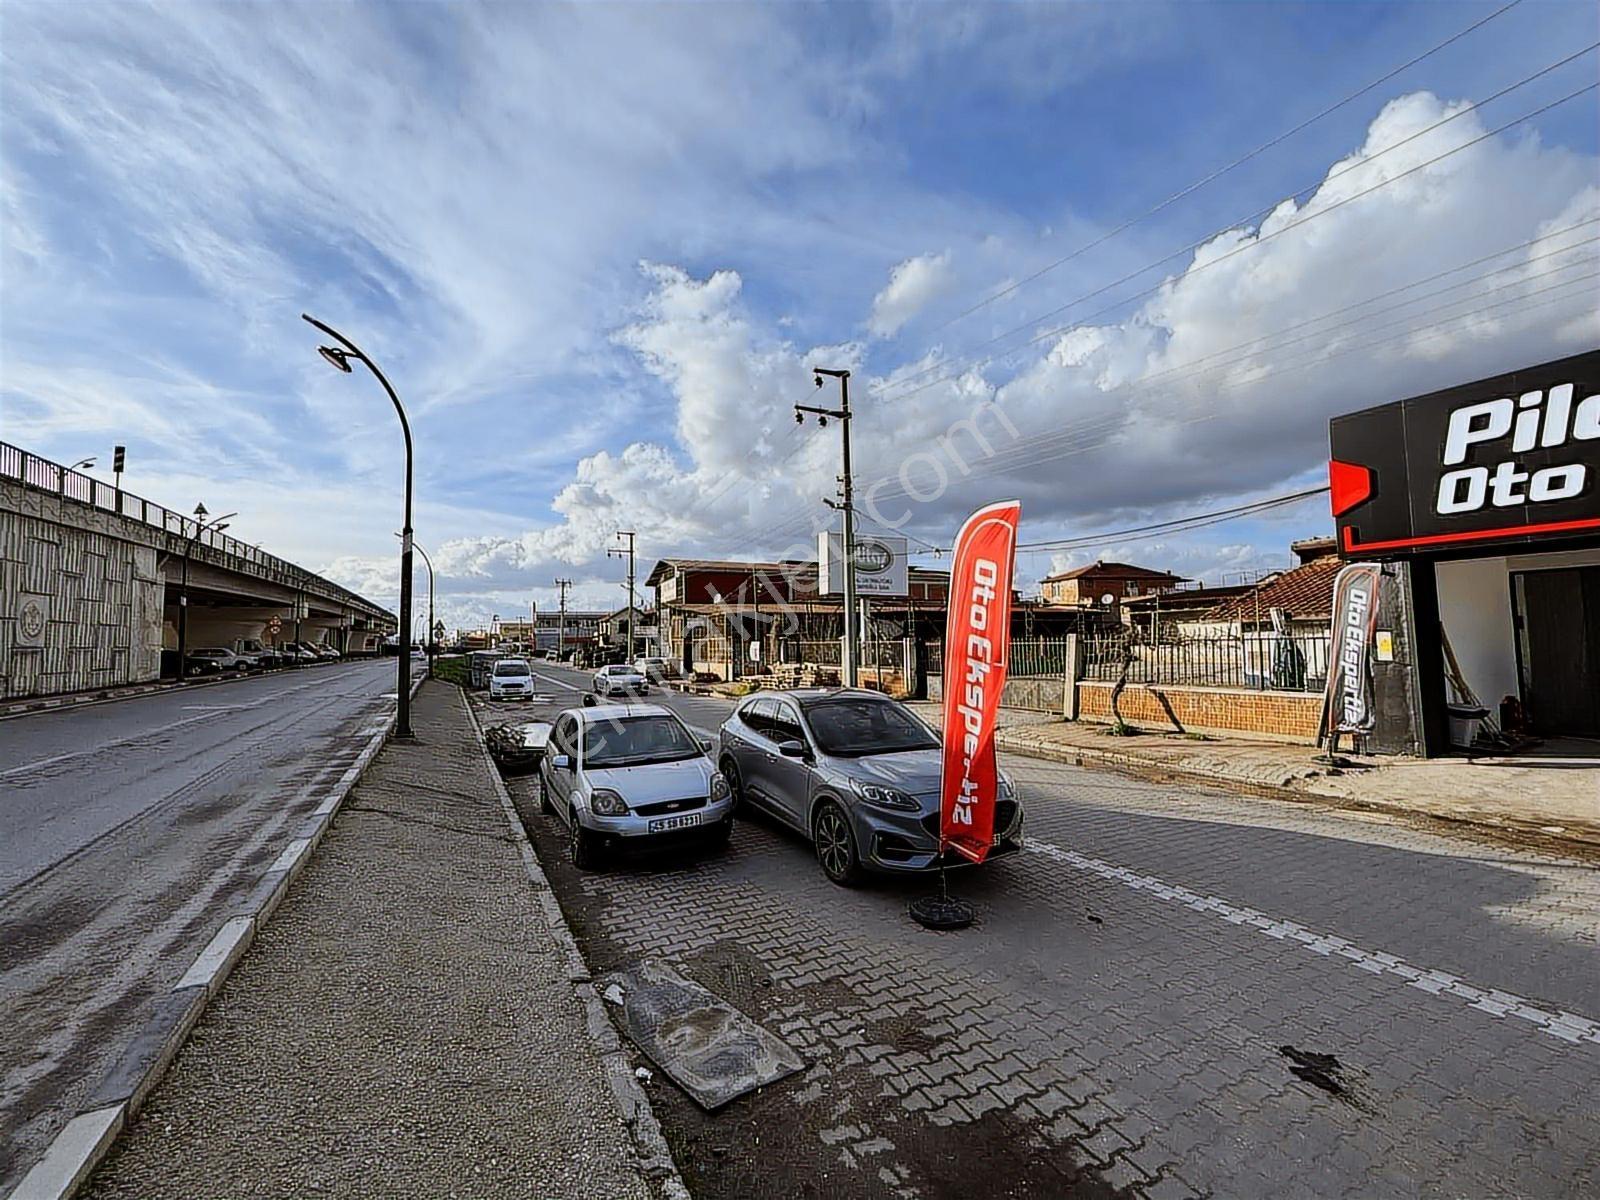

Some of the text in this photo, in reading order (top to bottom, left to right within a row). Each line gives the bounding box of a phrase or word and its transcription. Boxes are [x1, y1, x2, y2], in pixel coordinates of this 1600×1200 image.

[1436, 462, 1586, 514] Oto
[969, 558, 998, 631] Oto
[1347, 588, 1367, 624] Oto
